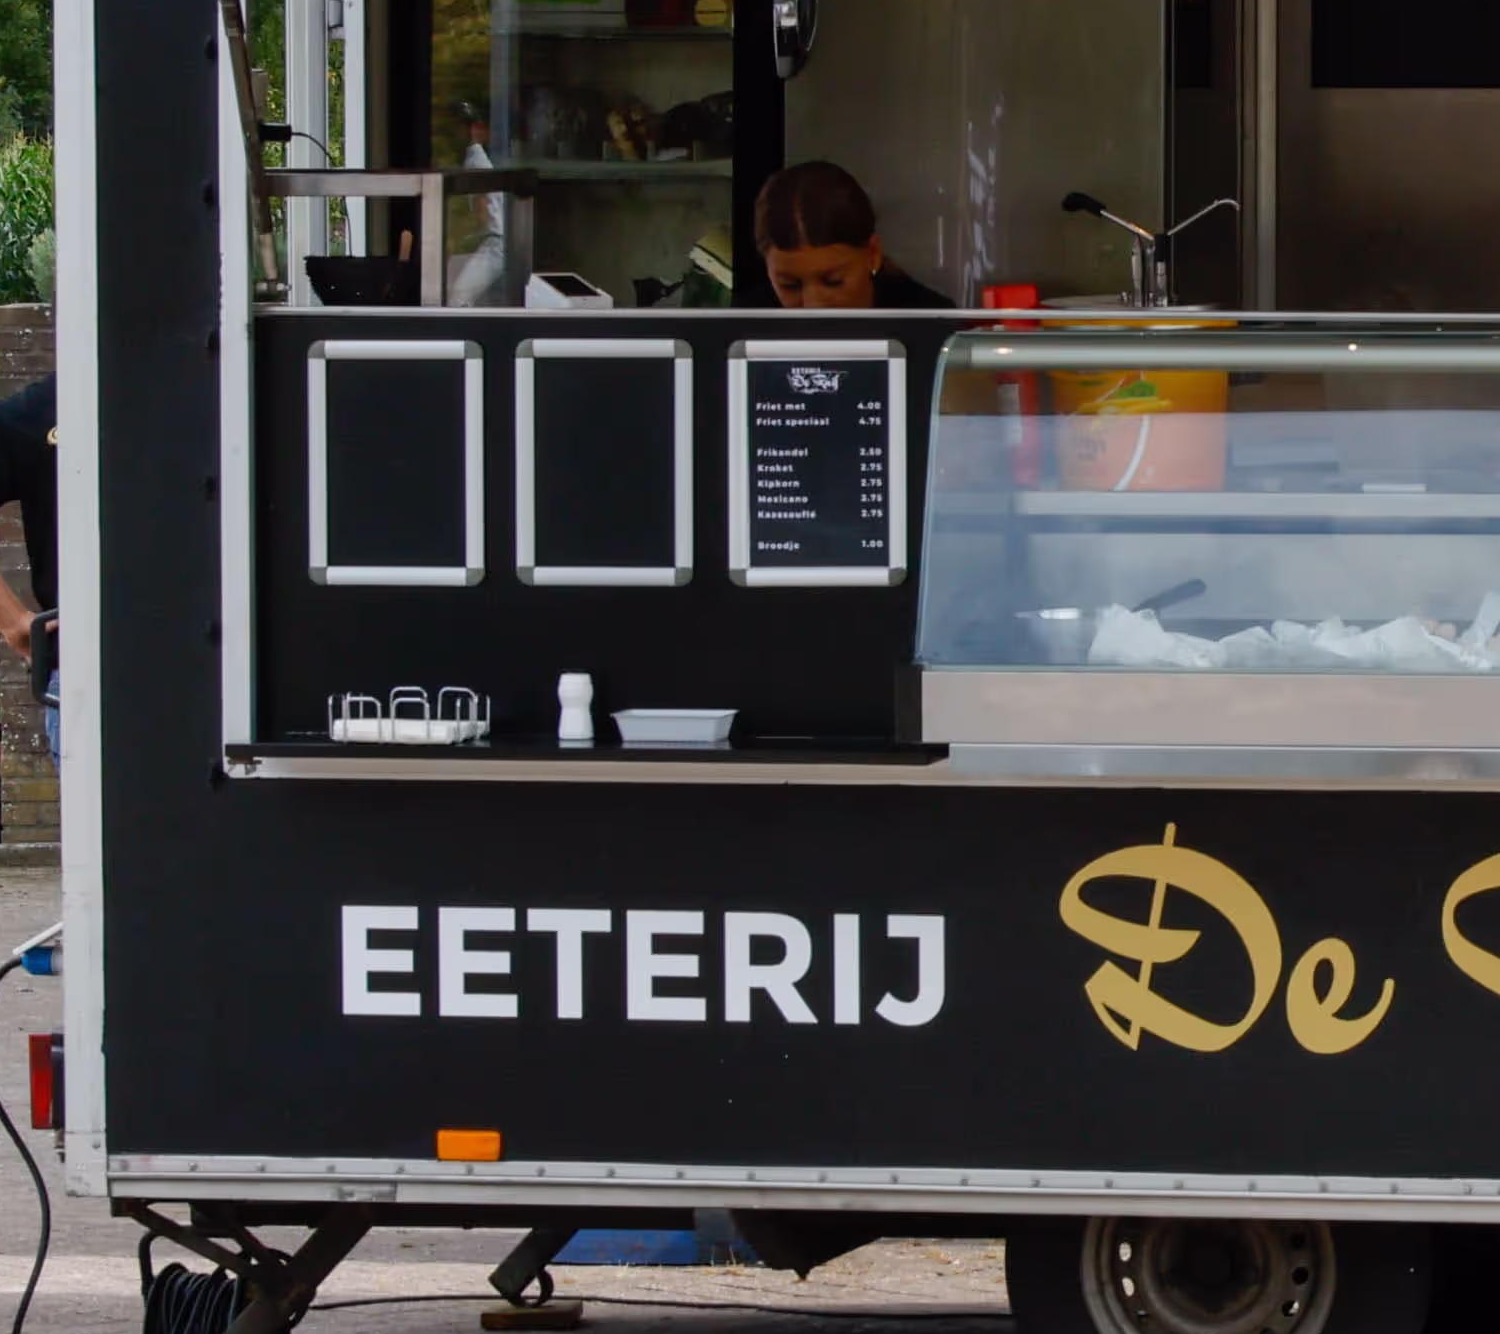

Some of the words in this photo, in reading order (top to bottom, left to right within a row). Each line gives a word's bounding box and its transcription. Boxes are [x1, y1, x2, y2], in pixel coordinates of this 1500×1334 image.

[755, 402, 782, 411] Friet
[784, 402, 806, 411] met
[756, 417, 782, 426] Friet
[756, 447, 809, 457] Frikandel
[757, 494, 809, 504] Mexicano
[757, 541, 800, 551] Broodje
[340, 903, 948, 1028] EETERIJ
[1057, 821, 1395, 1056] De
